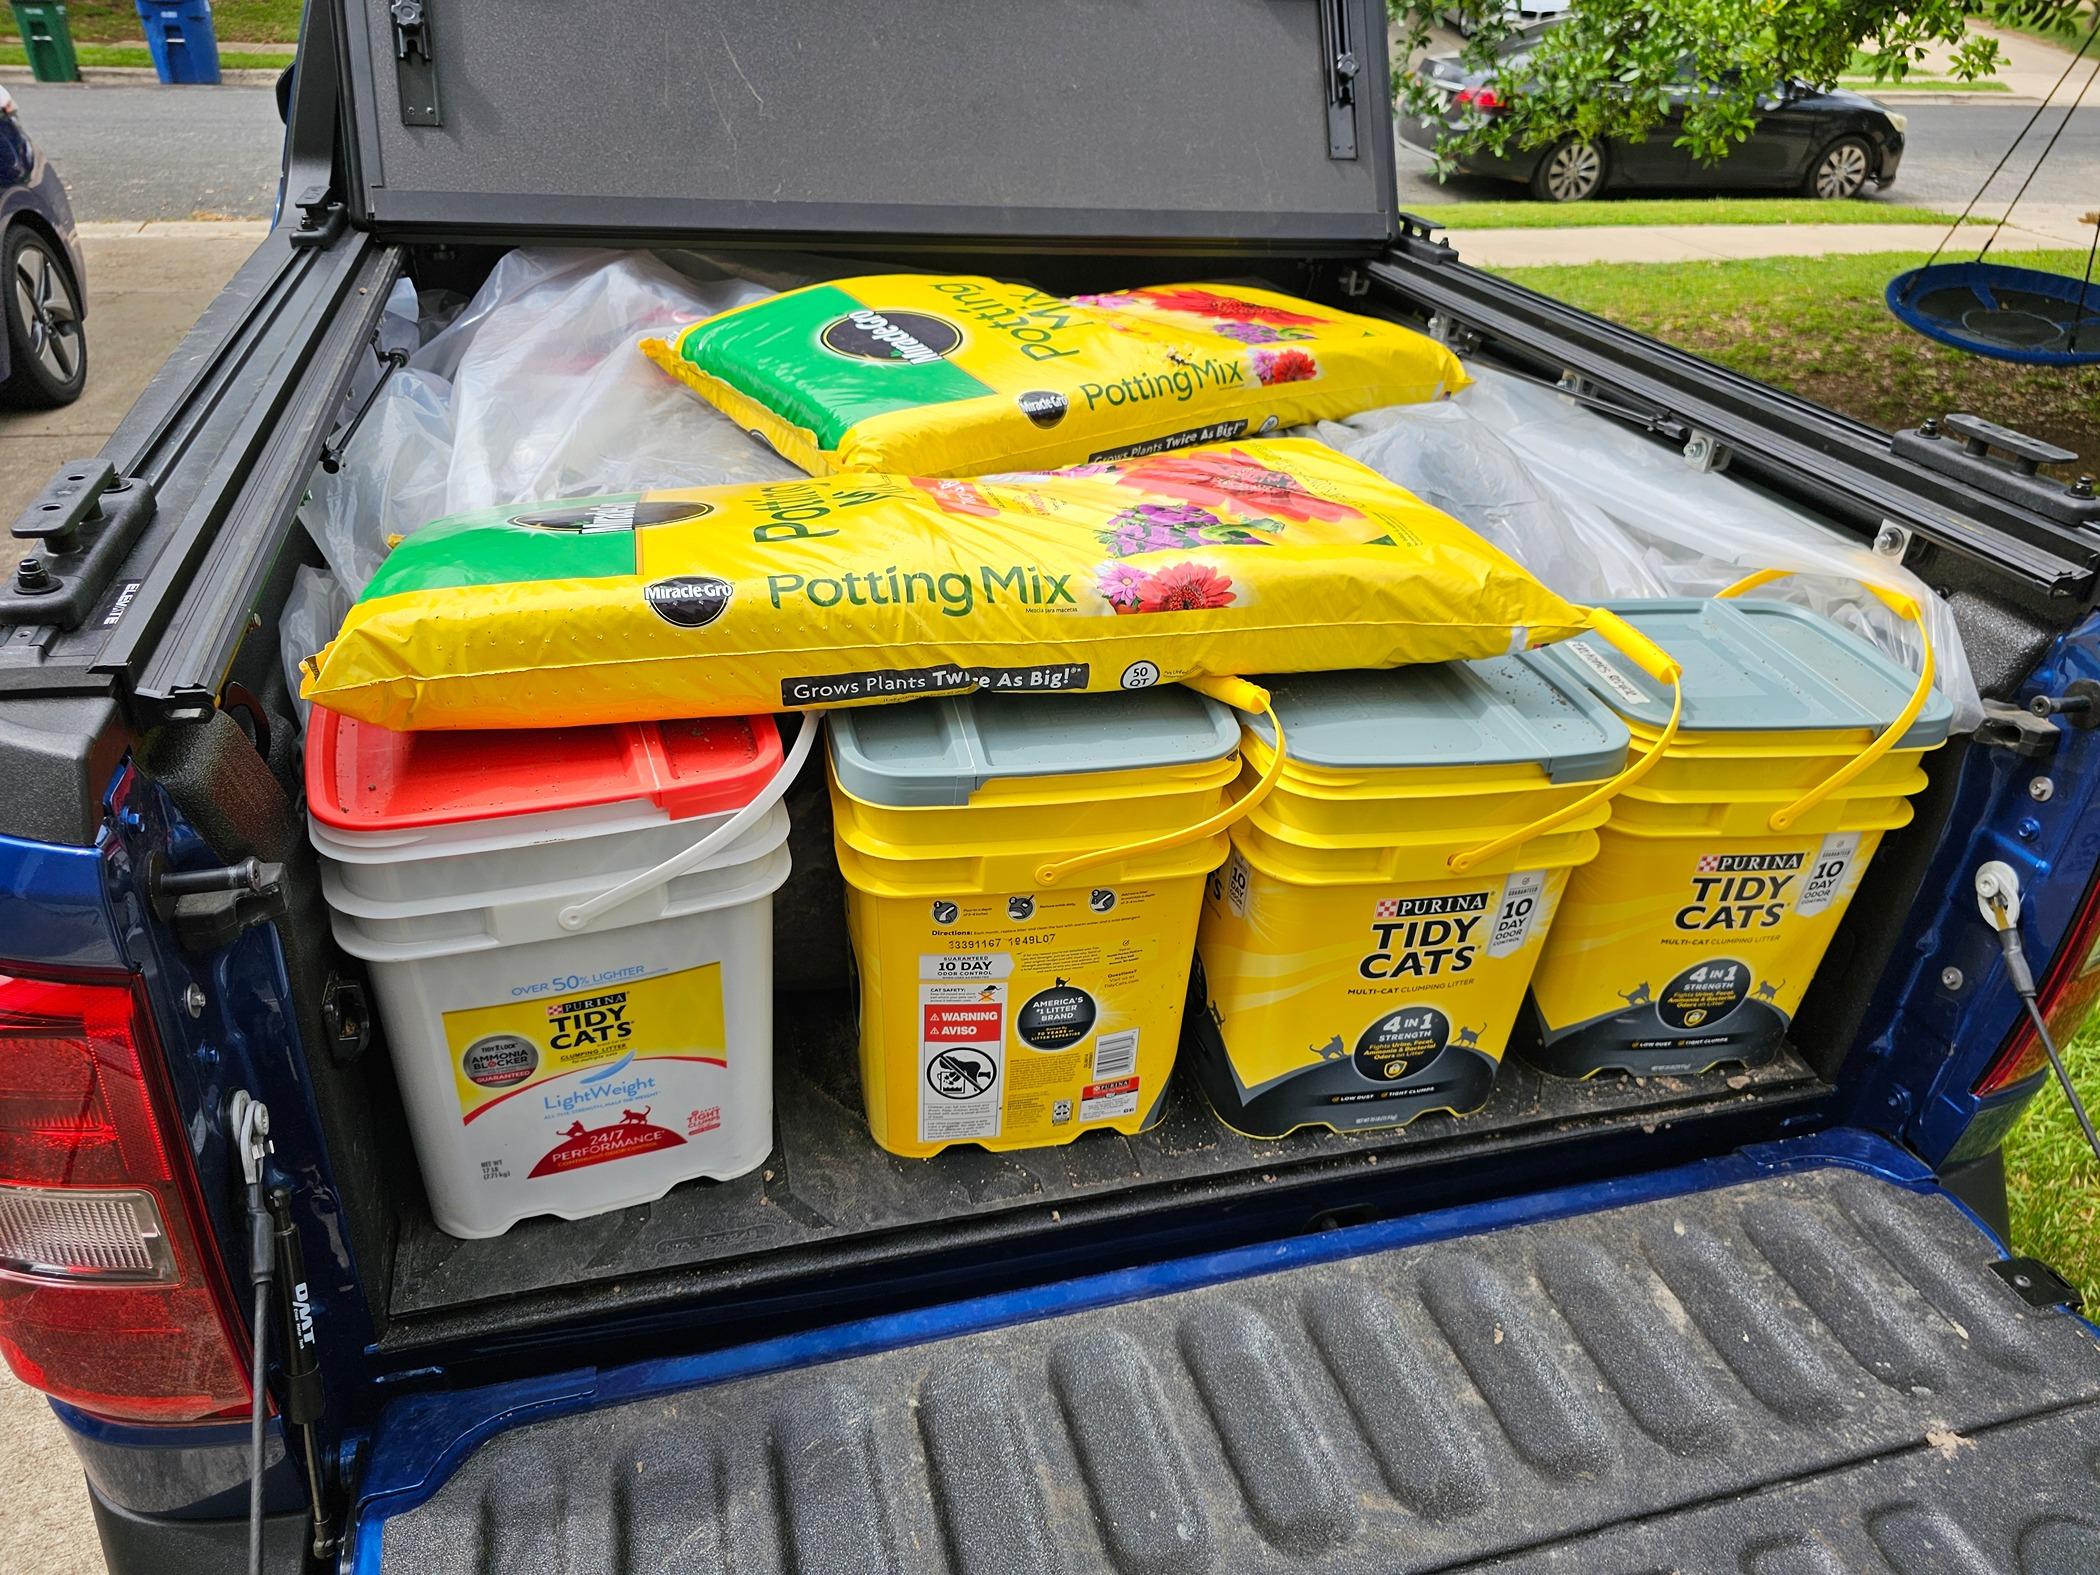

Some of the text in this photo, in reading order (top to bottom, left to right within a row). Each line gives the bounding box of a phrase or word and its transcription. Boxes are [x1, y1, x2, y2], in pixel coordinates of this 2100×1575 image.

[929, 283, 1080, 361] Potting
[1080, 358, 1244, 411] Potting Mix
[1020, 393, 1068, 413] Miracle-Gro
[1131, 442, 1162, 458] Plants
[1166, 434, 1197, 449] Twice
[1200, 426, 1214, 440] As
[644, 582, 734, 600] Miracle-Gro
[767, 565, 1077, 617] Potting Mix
[103, 583, 140, 625] ELEVATE
[1133, 667, 1148, 677] 50
[794, 682, 859, 699] Grows
[867, 675, 926, 691] Plants
[997, 672, 1022, 687] As
[1720, 855, 1799, 870] PURINA
[1814, 861, 1844, 880] 10
[1692, 875, 1795, 902] TIDY
[1808, 878, 1837, 890] DAY
[1804, 889, 1831, 898] ODOR
[1400, 895, 1484, 916] PURINA
[1502, 898, 1532, 920] 10
[1498, 917, 1527, 931] DAY
[1675, 903, 1784, 929] CATS
[1372, 916, 1482, 949] TIDY
[1495, 929, 1523, 941] ODOR
[1711, 937, 1752, 945] CLUMPING
[1754, 935, 1780, 943] LITTER
[939, 961, 992, 971] 10 DAY
[1359, 945, 1475, 978] CATS
[511, 983, 549, 996] OVER
[552, 975, 590, 991] 50%
[592, 965, 645, 983] LIGHTER
[1108, 970, 1137, 978] Questions?
[1690, 965, 1738, 982] 4 IN 1
[1347, 978, 1475, 995] MULTI-CAT CLUMPING LITTER
[1684, 983, 1734, 991] STRENGTH
[565, 994, 625, 1012] PURINA
[1033, 997, 1083, 1008] AMERICA'S
[1046, 1005, 1077, 1014] LITTER
[549, 1005, 626, 1032] TIDY
[942, 1012, 998, 1021] WARNING
[1042, 1013, 1073, 1021] BRAND
[1383, 1013, 1432, 1032] 4 IN 1
[550, 1022, 632, 1049] CATS
[942, 1026, 977, 1035] AVISO
[1379, 1030, 1432, 1042] STRENGTH
[472, 1050, 528, 1063] AMMONIA
[560, 1043, 627, 1061] CLUMPING LITTER
[474, 1056, 528, 1069] BLOCKER
[476, 1070, 530, 1082] GUARANTEED
[544, 1076, 656, 1111] LightWeight
[687, 1108, 720, 1122] TIGHT
[590, 1129, 625, 1145] 24/7
[552, 1131, 662, 1162] PERFORMANCE
